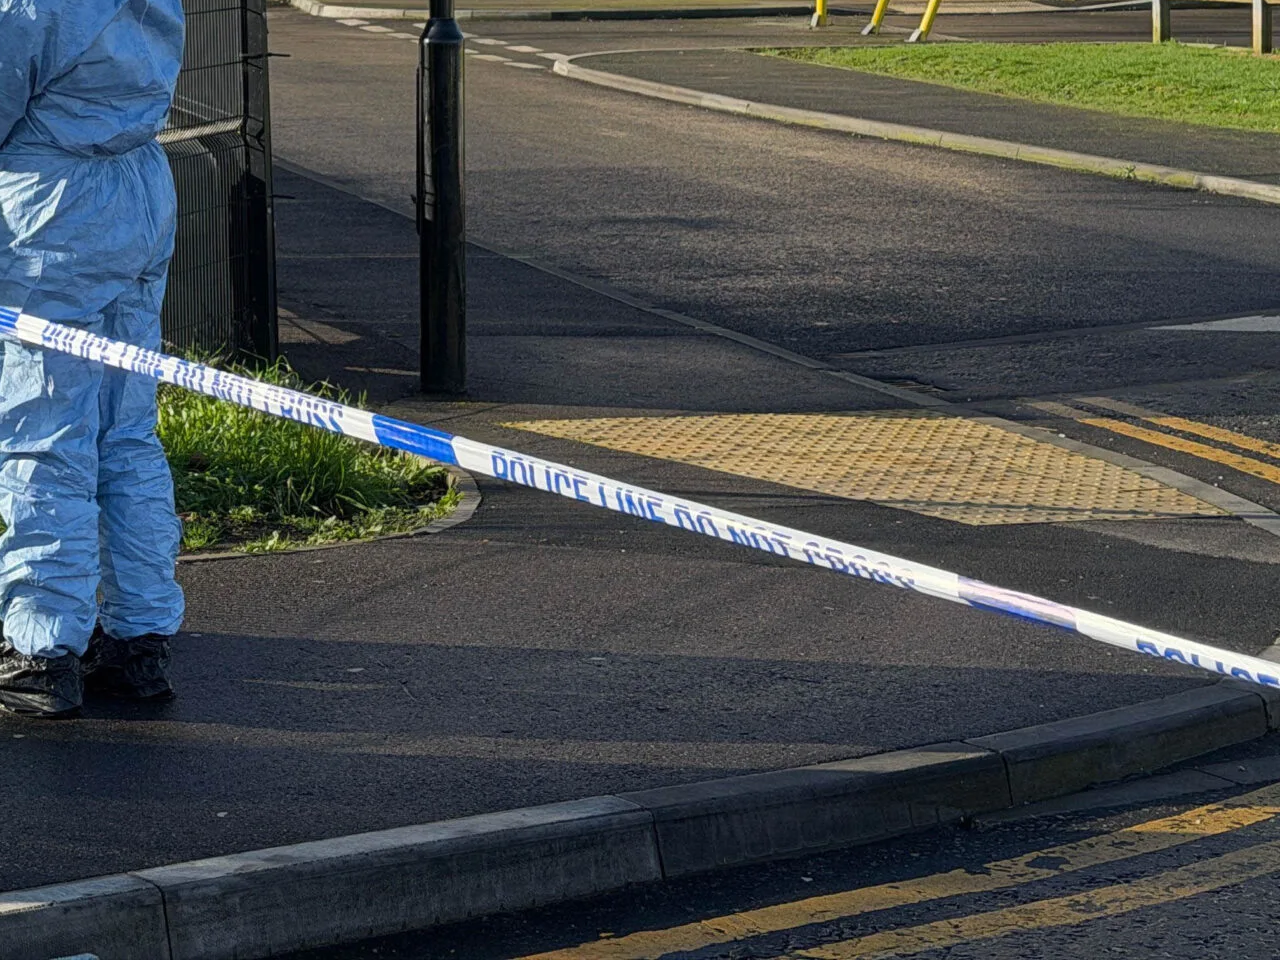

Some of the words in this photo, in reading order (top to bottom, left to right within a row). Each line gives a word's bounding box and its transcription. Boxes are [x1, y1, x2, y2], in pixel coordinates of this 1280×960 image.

[491, 450, 590, 503] POLICE
[597, 481, 665, 523] LINE
[673, 503, 720, 537] DO
[726, 518, 793, 558] NOT
